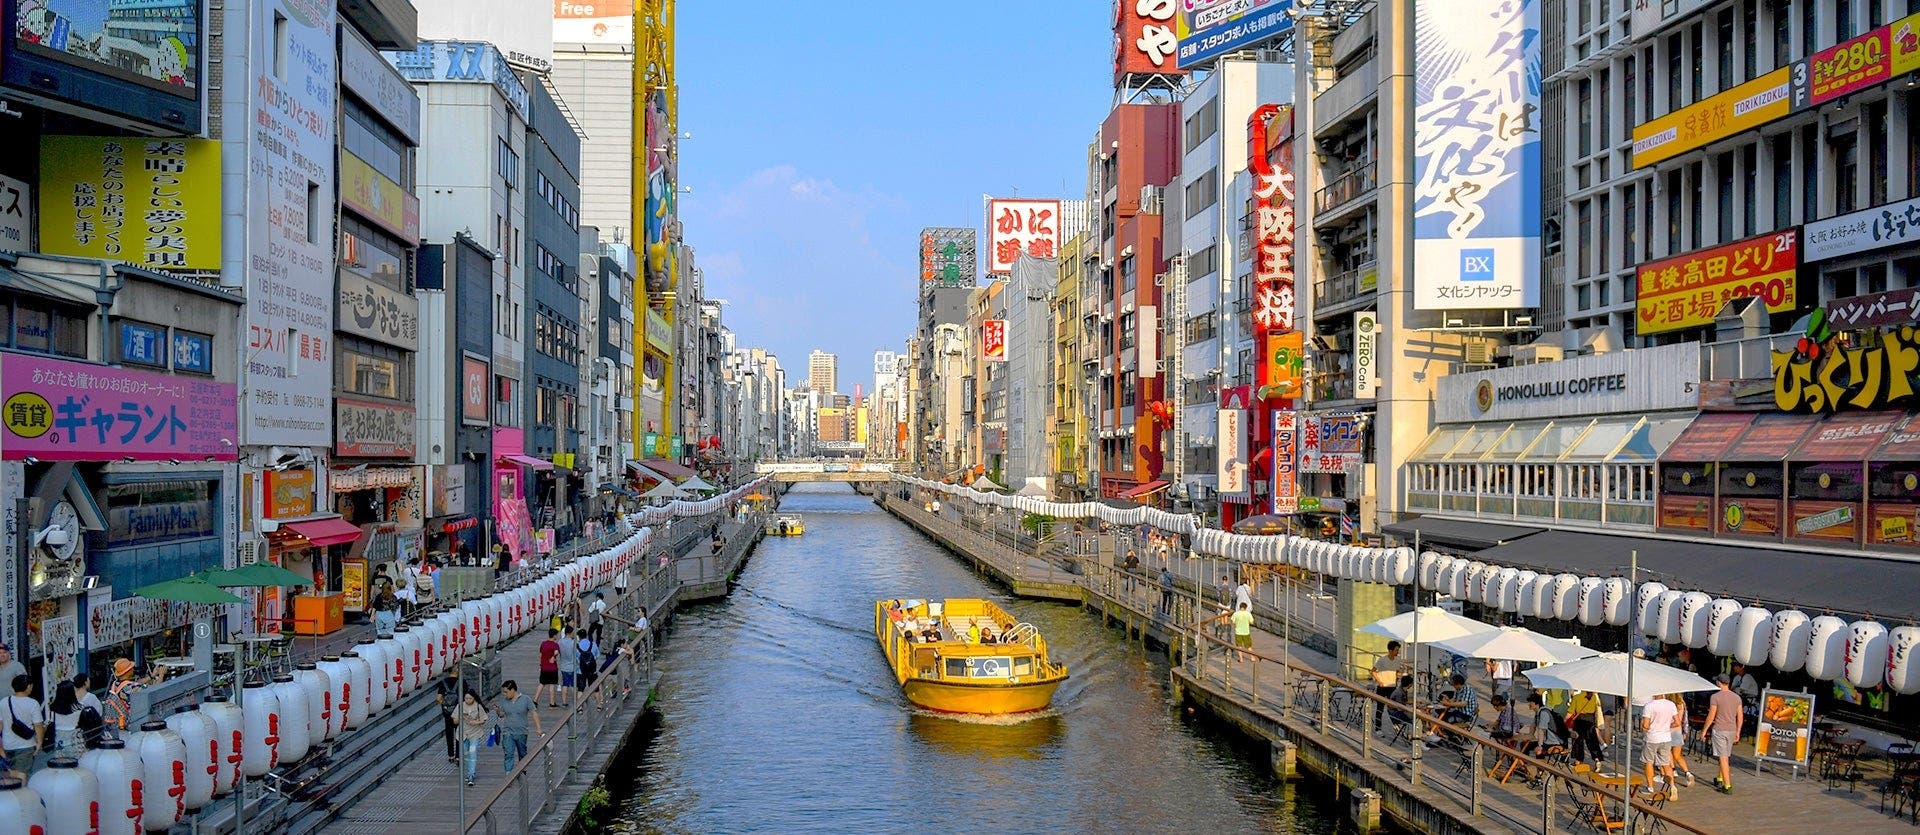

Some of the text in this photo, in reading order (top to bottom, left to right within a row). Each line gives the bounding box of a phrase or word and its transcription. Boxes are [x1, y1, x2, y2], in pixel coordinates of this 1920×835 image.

[560, 3, 594, 16] Free
[1793, 62, 1807, 107] 3F
[1735, 87, 1783, 113] TORIKIZOKU
[1634, 131, 1672, 152] TORIKIZOKU
[102, 141, 124, 254] あなたのお店づくり
[144, 141, 187, 267] 素晴らしい夢の実現
[73, 182, 97, 246] 応援します
[996, 207, 1053, 235] かに
[1775, 231, 1795, 252] 2F
[1809, 230, 1827, 244] 大阪
[1830, 220, 1867, 240] お好み焼
[1253, 164, 1295, 332] 大阪王将
[1465, 257, 1490, 272] BX
[1639, 243, 1774, 296] 豊後高田どり
[1659, 290, 1716, 324] 酒場
[132, 330, 146, 359] 酒
[174, 336, 200, 368] たばこ
[251, 325, 327, 362] コスパ 最高!
[1359, 335, 1370, 367] ZERO
[32, 368, 186, 399] あなたも憧れのお店のオーナーに!
[1498, 373, 1626, 400] HONOLULU COFFEE
[10, 402, 46, 428] 賃貸
[56, 395, 187, 446] ギャラント
[50, 432, 59, 444] の
[1320, 455, 1342, 470] 免税
[127, 506, 198, 535] FamilyMart
